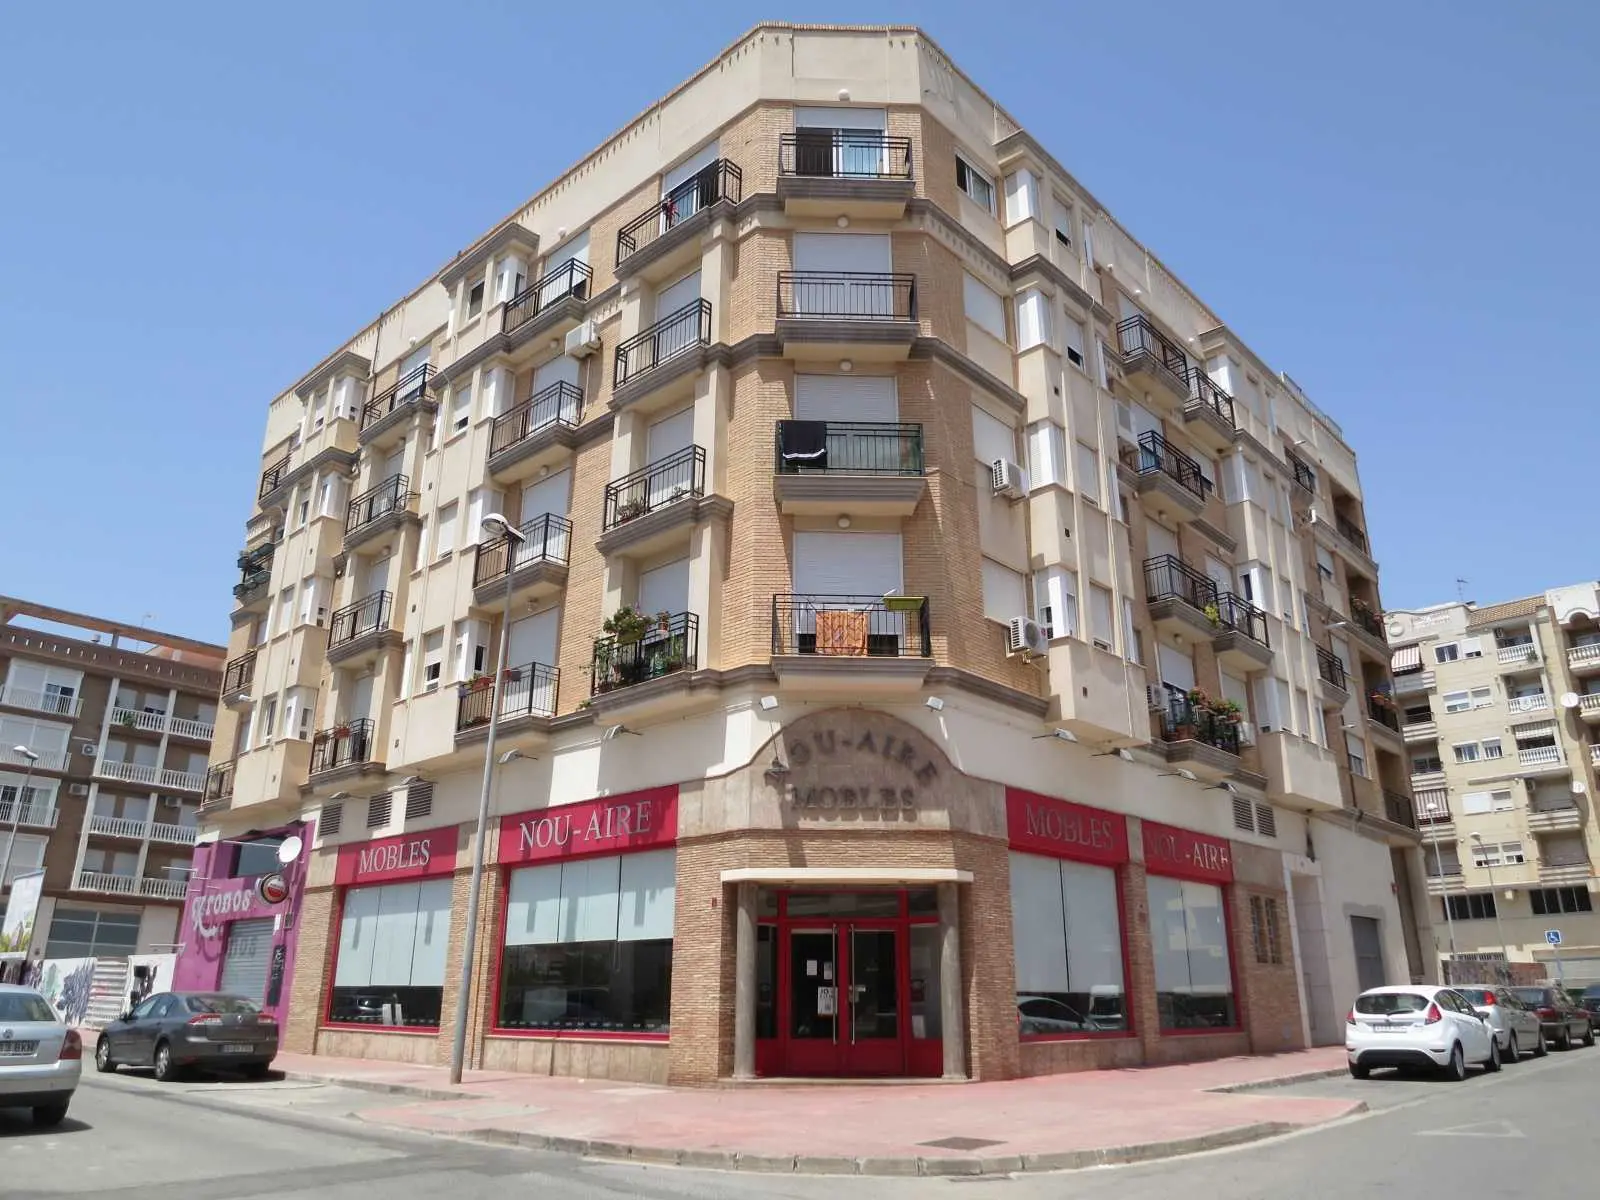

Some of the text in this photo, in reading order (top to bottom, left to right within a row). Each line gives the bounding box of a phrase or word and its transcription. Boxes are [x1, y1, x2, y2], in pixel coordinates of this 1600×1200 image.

[790, 785, 915, 809] MOBLES
[518, 801, 652, 851] NOU-AIRE
[1025, 803, 1114, 849] MOBLES
[358, 839, 431, 874] MOBLES
